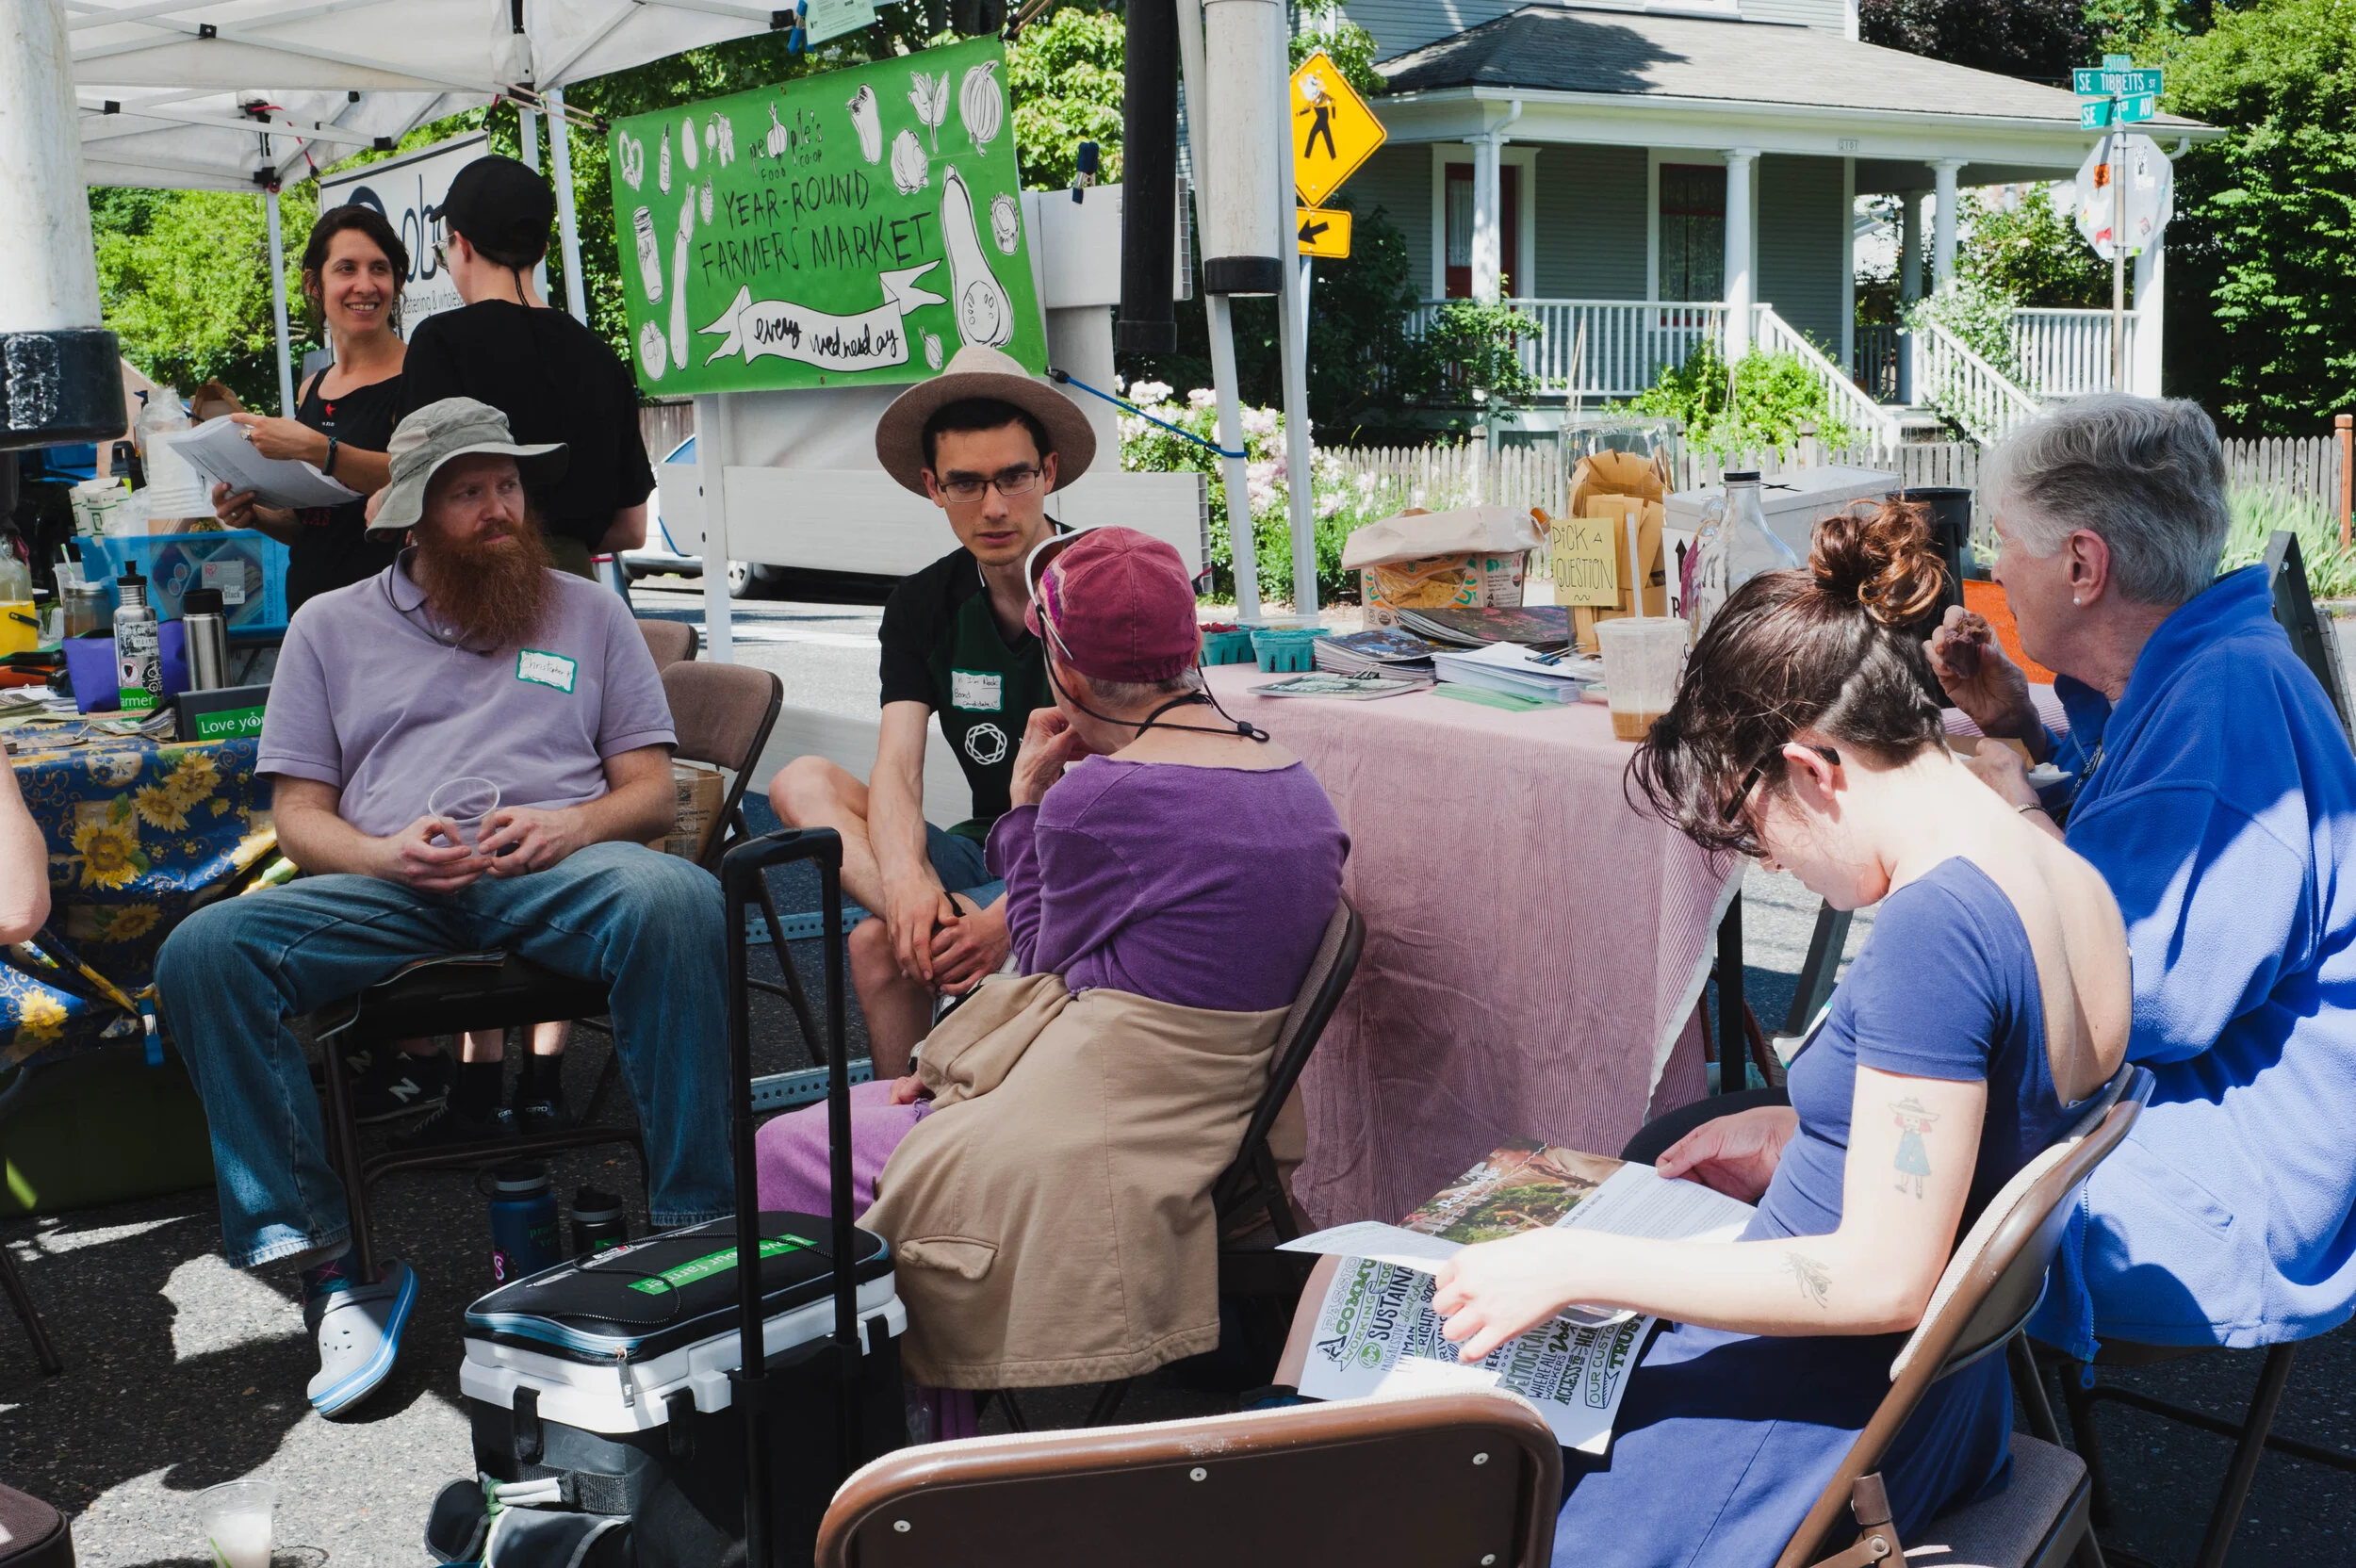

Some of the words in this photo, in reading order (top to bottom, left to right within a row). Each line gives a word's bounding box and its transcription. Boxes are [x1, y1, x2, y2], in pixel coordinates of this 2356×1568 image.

[2079, 73, 2091, 91] SE
[2101, 73, 2144, 91] TIBBETTS
[2083, 106, 2096, 125] SE
[2139, 97, 2151, 117] AV
[761, 167, 786, 184] FOOD
[722, 169, 869, 231] YEAR-ROUND
[700, 227, 799, 286] FARMERS
[811, 212, 931, 271] MARKET
[754, 318, 802, 350] every
[1593, 532, 1602, 543] A
[120, 696, 153, 707] armer
[201, 719, 235, 733] Love
[1341, 1295, 1376, 1360] WORKING
[1418, 1307, 1437, 1346] RIGHTS
[1529, 1366, 1550, 1398] WHERE
[1544, 1353, 1558, 1368] ALL
[1543, 1355, 1566, 1400] WORKERS
[1554, 1364, 1582, 1406] ACCESS
[1589, 1371, 1601, 1404] OUR
